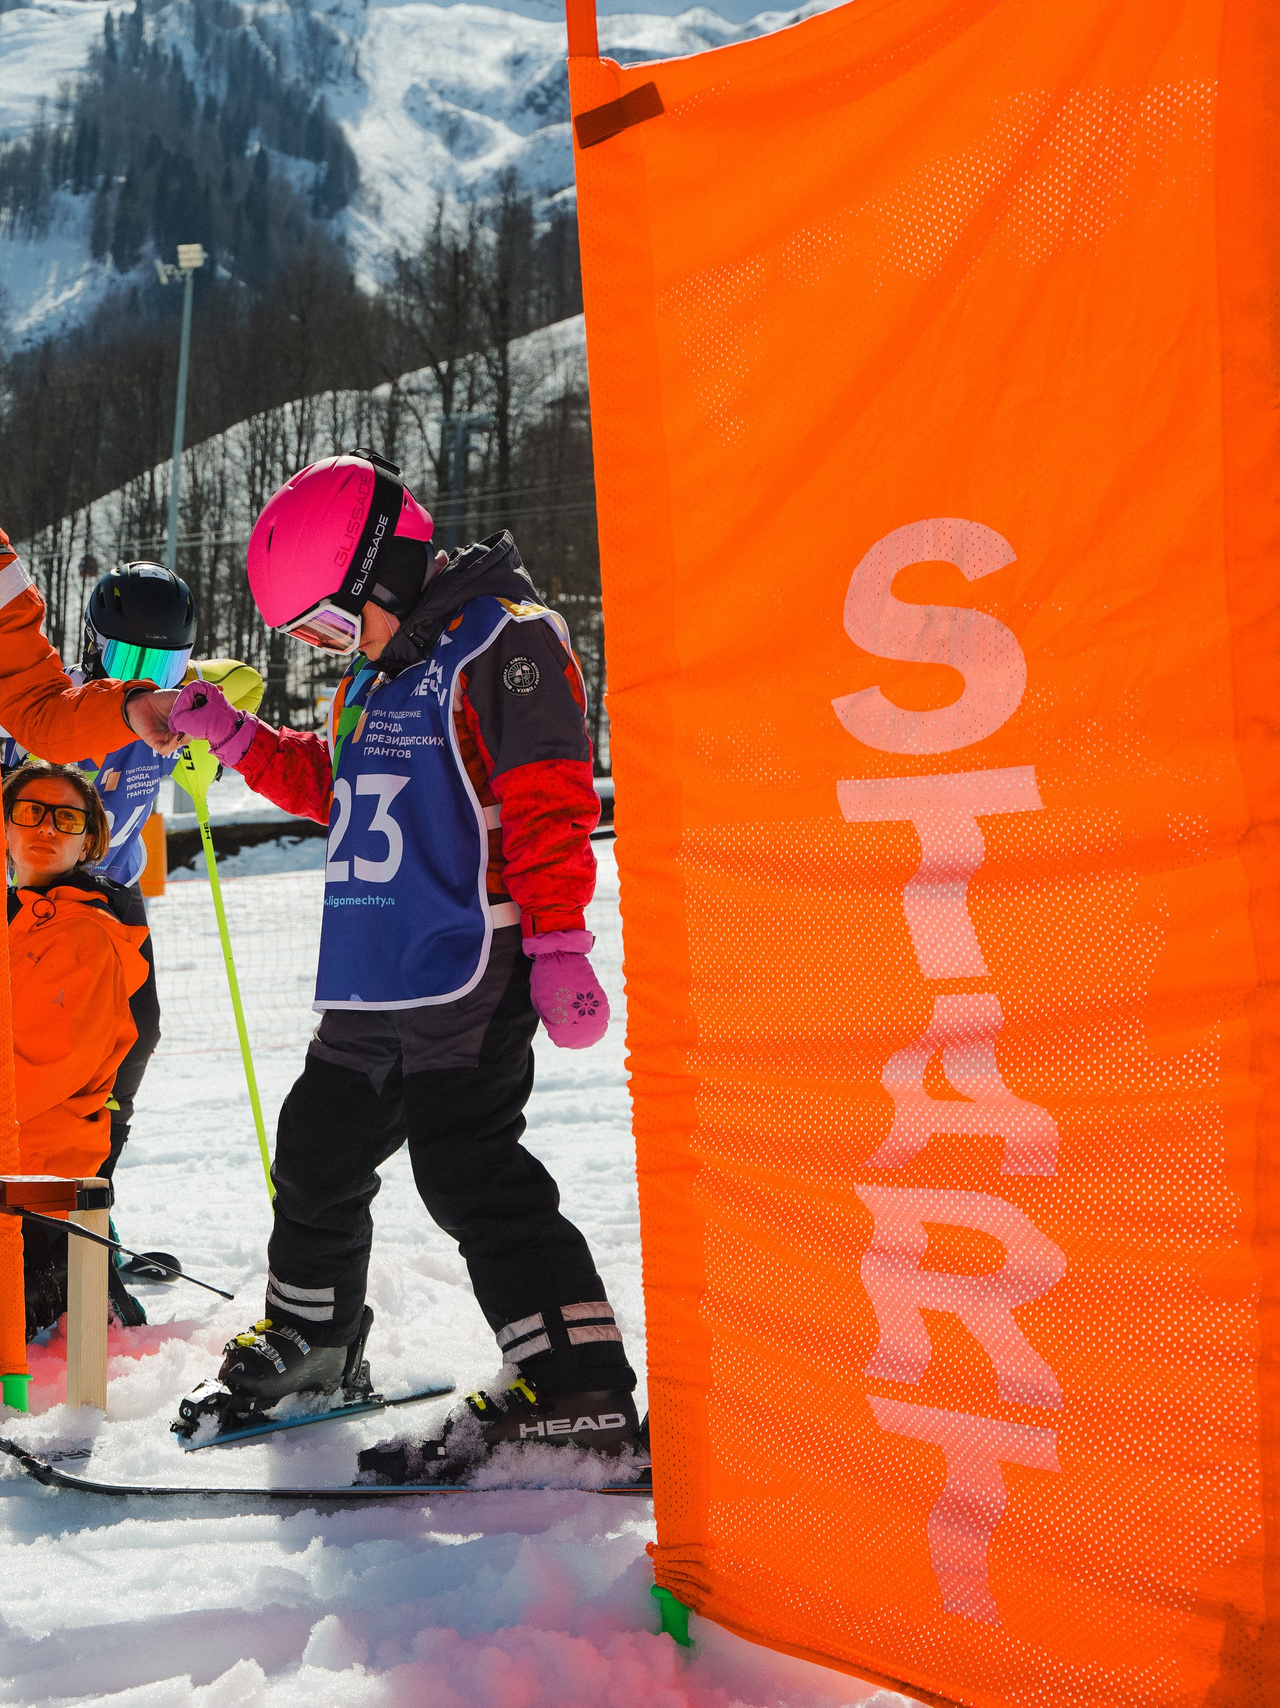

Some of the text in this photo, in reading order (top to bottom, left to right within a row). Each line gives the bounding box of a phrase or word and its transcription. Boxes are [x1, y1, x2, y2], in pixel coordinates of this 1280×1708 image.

[334, 473, 372, 567] GLISSADE
[351, 514, 388, 595] GLISSADE
[368, 720, 403, 733] ФОНДА
[371, 709, 421, 719] ПРИ ПОДДЕРЖКЕ
[363, 746, 412, 759] ГРАНТОВ
[365, 734, 445, 746] ПРЕЗИДЕНТСКИХ
[182, 745, 195, 771] LE
[126, 773, 150, 783] ФОНДА
[325, 773, 411, 883] 23
[830, 517, 1066, 1626] START
[519, 1413, 626, 1438] HEAD
